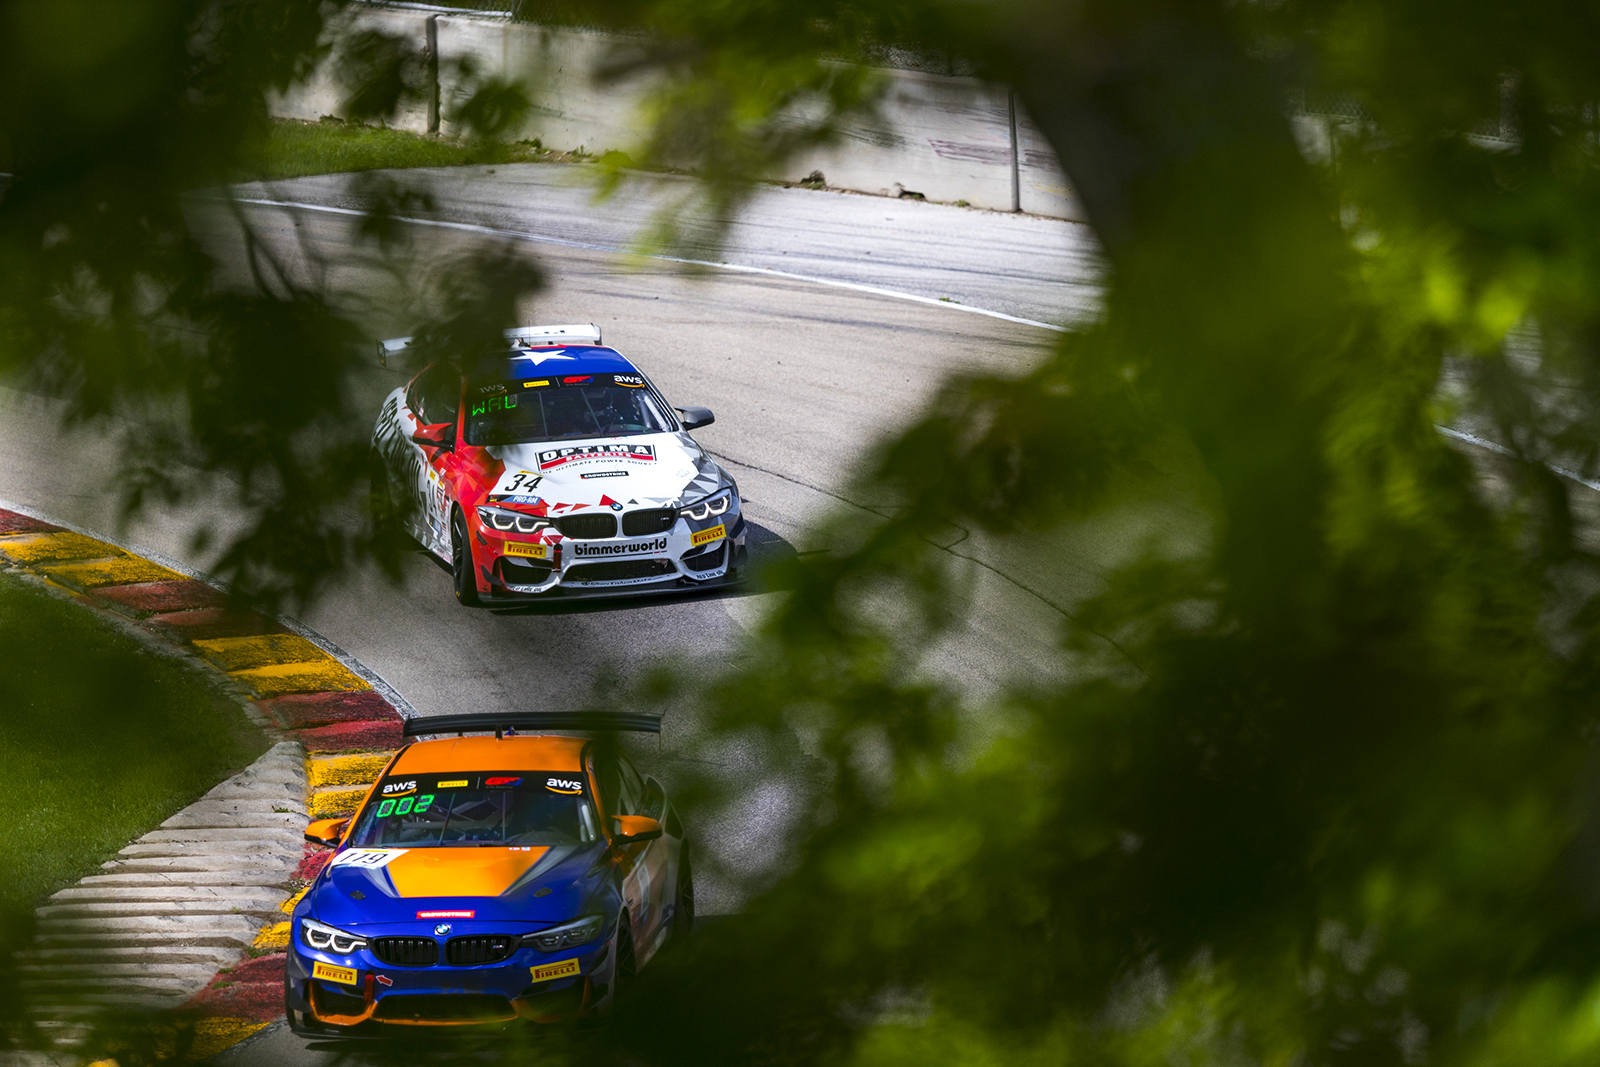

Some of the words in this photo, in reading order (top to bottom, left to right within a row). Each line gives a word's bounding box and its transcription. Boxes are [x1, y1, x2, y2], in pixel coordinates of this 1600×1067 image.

[614, 375, 643, 384] aws
[542, 446, 649, 461] OPTIMA
[565, 452, 631, 461] BATTERIES
[556, 460, 592, 471] ULTIMATE
[504, 474, 543, 493] 34
[693, 527, 725, 544] PIRELLI
[507, 543, 544, 556] PIRELLI
[574, 538, 667, 556] bimmerworld
[383, 781, 417, 794] aws
[547, 778, 582, 790] aws
[377, 795, 434, 818] 002
[339, 852, 388, 864] 119
[314, 966, 354, 982] PIRELLI
[533, 964, 577, 980] PIRELLI
